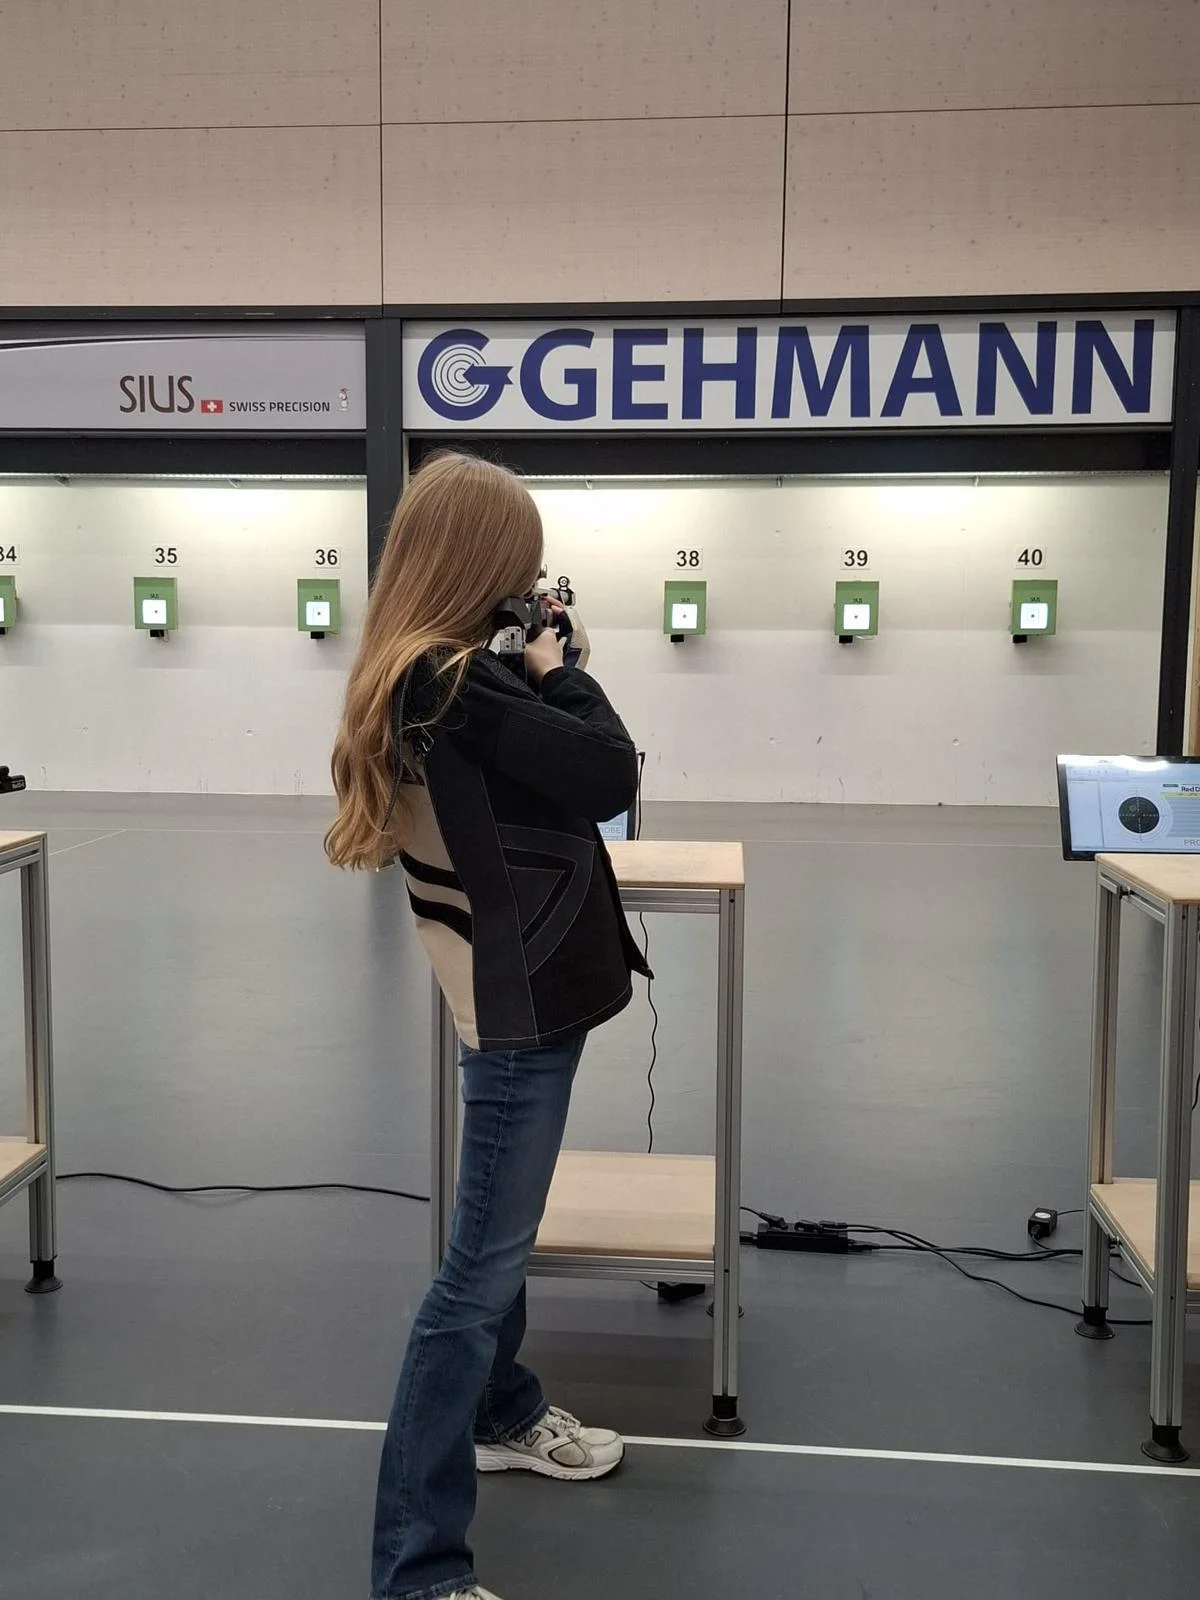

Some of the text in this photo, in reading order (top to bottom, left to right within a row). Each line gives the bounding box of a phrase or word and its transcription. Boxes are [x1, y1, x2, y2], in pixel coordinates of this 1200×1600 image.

[519, 318, 1155, 421] GEHMANN
[119, 375, 195, 413] SIUS
[228, 401, 331, 413] SWISS PRECISION
[155, 547, 178, 564] 35
[315, 548, 338, 565] 36
[676, 550, 700, 567] 38
[844, 549, 868, 567] 39
[1017, 548, 1043, 566] 40
